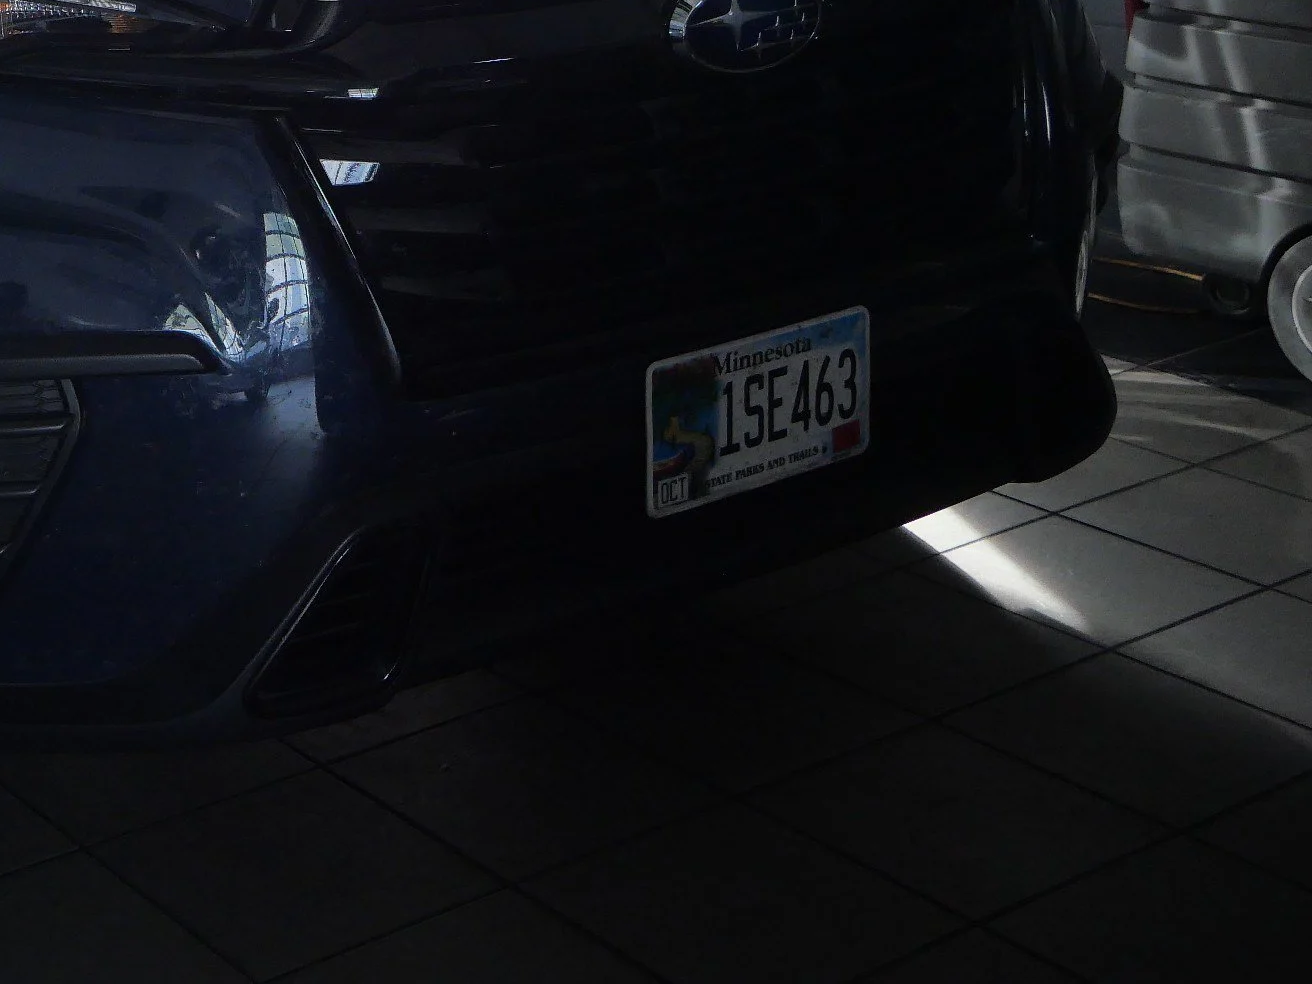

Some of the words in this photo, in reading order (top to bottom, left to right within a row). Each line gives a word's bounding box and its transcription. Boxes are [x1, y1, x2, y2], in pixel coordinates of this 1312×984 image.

[713, 336, 812, 376] Minnesota
[719, 348, 857, 456] 1SE463
[705, 474, 733, 489] STATE
[735, 464, 764, 481] PARKS
[767, 456, 785, 470] AND
[788, 447, 819, 463] TRAILS
[661, 477, 686, 504] OCT
